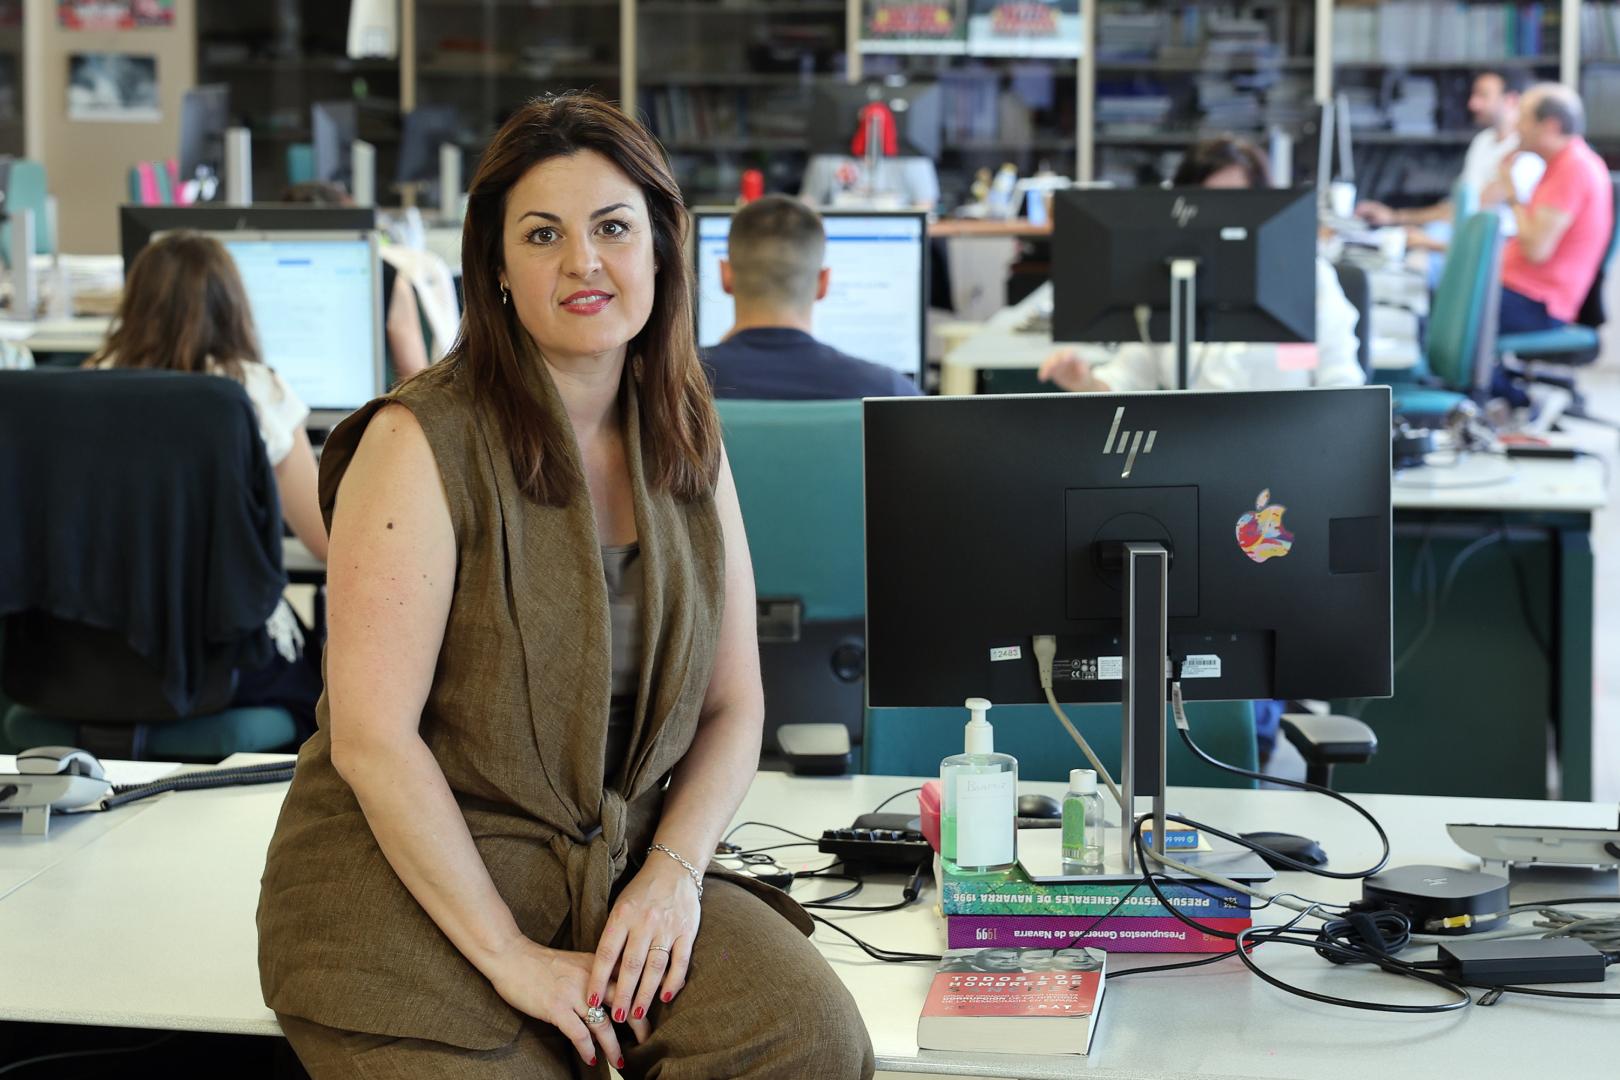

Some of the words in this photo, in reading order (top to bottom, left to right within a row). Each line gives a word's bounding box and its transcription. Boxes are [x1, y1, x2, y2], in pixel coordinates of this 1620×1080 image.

[1103, 406, 1157, 478] hp
[953, 893, 977, 902] 1996
[980, 893, 1033, 903] NAVARRA
[1037, 894, 1051, 903] DE
[1056, 895, 1119, 905] GENERALES
[1124, 896, 1210, 907] PRESUPESTOS
[975, 927, 998, 940] 1999
[1013, 929, 1052, 939] Navarra
[1054, 929, 1067, 939] de
[1119, 929, 1186, 940] Presupuestos
[951, 975, 1028, 983] TODOS
